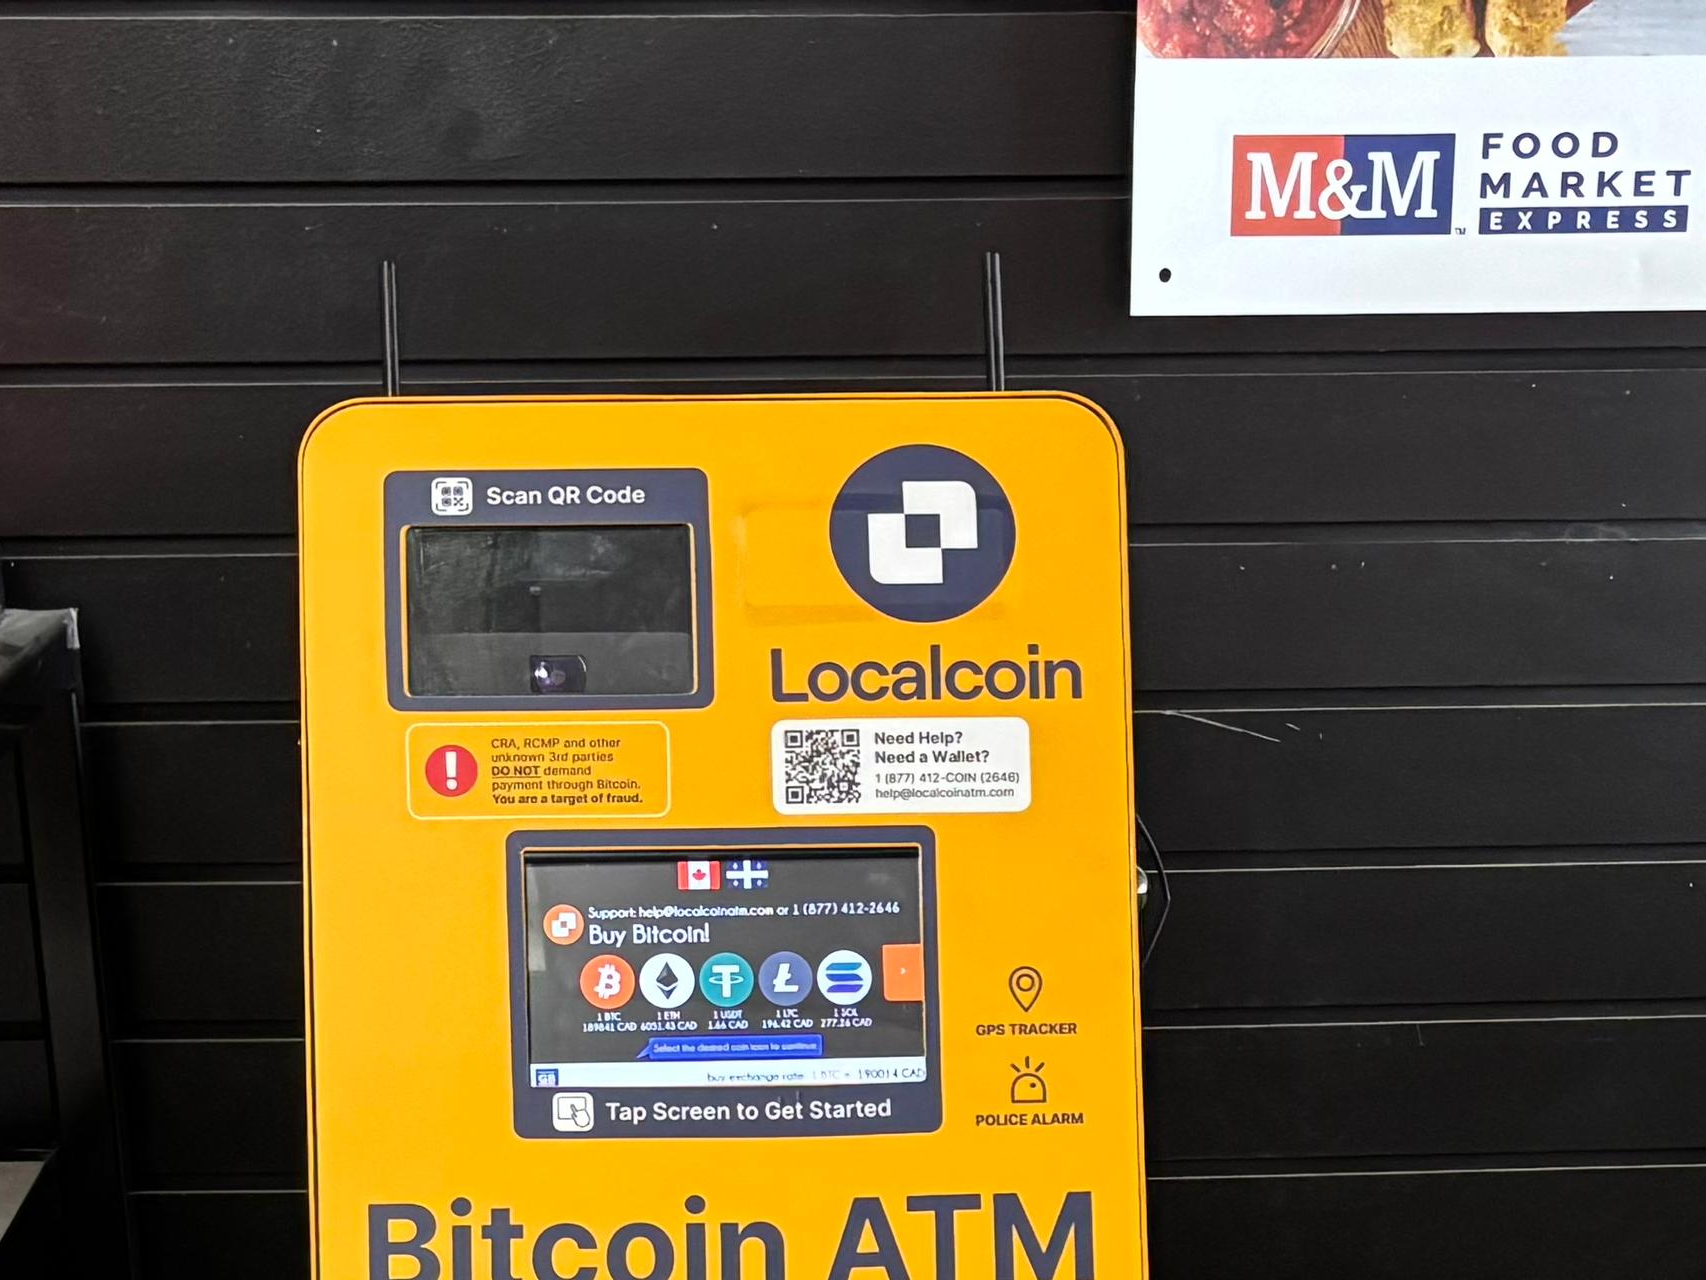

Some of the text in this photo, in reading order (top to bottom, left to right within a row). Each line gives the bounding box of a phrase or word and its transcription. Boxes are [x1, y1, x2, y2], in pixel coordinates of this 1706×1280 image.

[1481, 131, 1619, 159] FOOD
[1244, 150, 1442, 221] M&M
[1479, 169, 1692, 200] MARKET
[1489, 208, 1679, 231] EXPRESS
[486, 482, 646, 508] Scan QR Code
[770, 643, 1084, 703] Localcoin
[491, 738, 621, 750] CRA, RCMP and other
[874, 731, 963, 746] Need Help?
[875, 750, 990, 763] Need a Wallet?
[492, 779, 641, 792] payment through Bitcoin.
[885, 773, 915, 784] (877)
[919, 773, 977, 783] 412-COIN
[980, 772, 1020, 783] (2646)
[875, 788, 1014, 800] help@localcoinatm.com
[588, 922, 710, 947] Buy Bitcoin!
[976, 1021, 1078, 1036] GPS TRACKER
[606, 1098, 891, 1122] Tap Screen to Get Started
[975, 1111, 1084, 1127] POLICE ALARM
